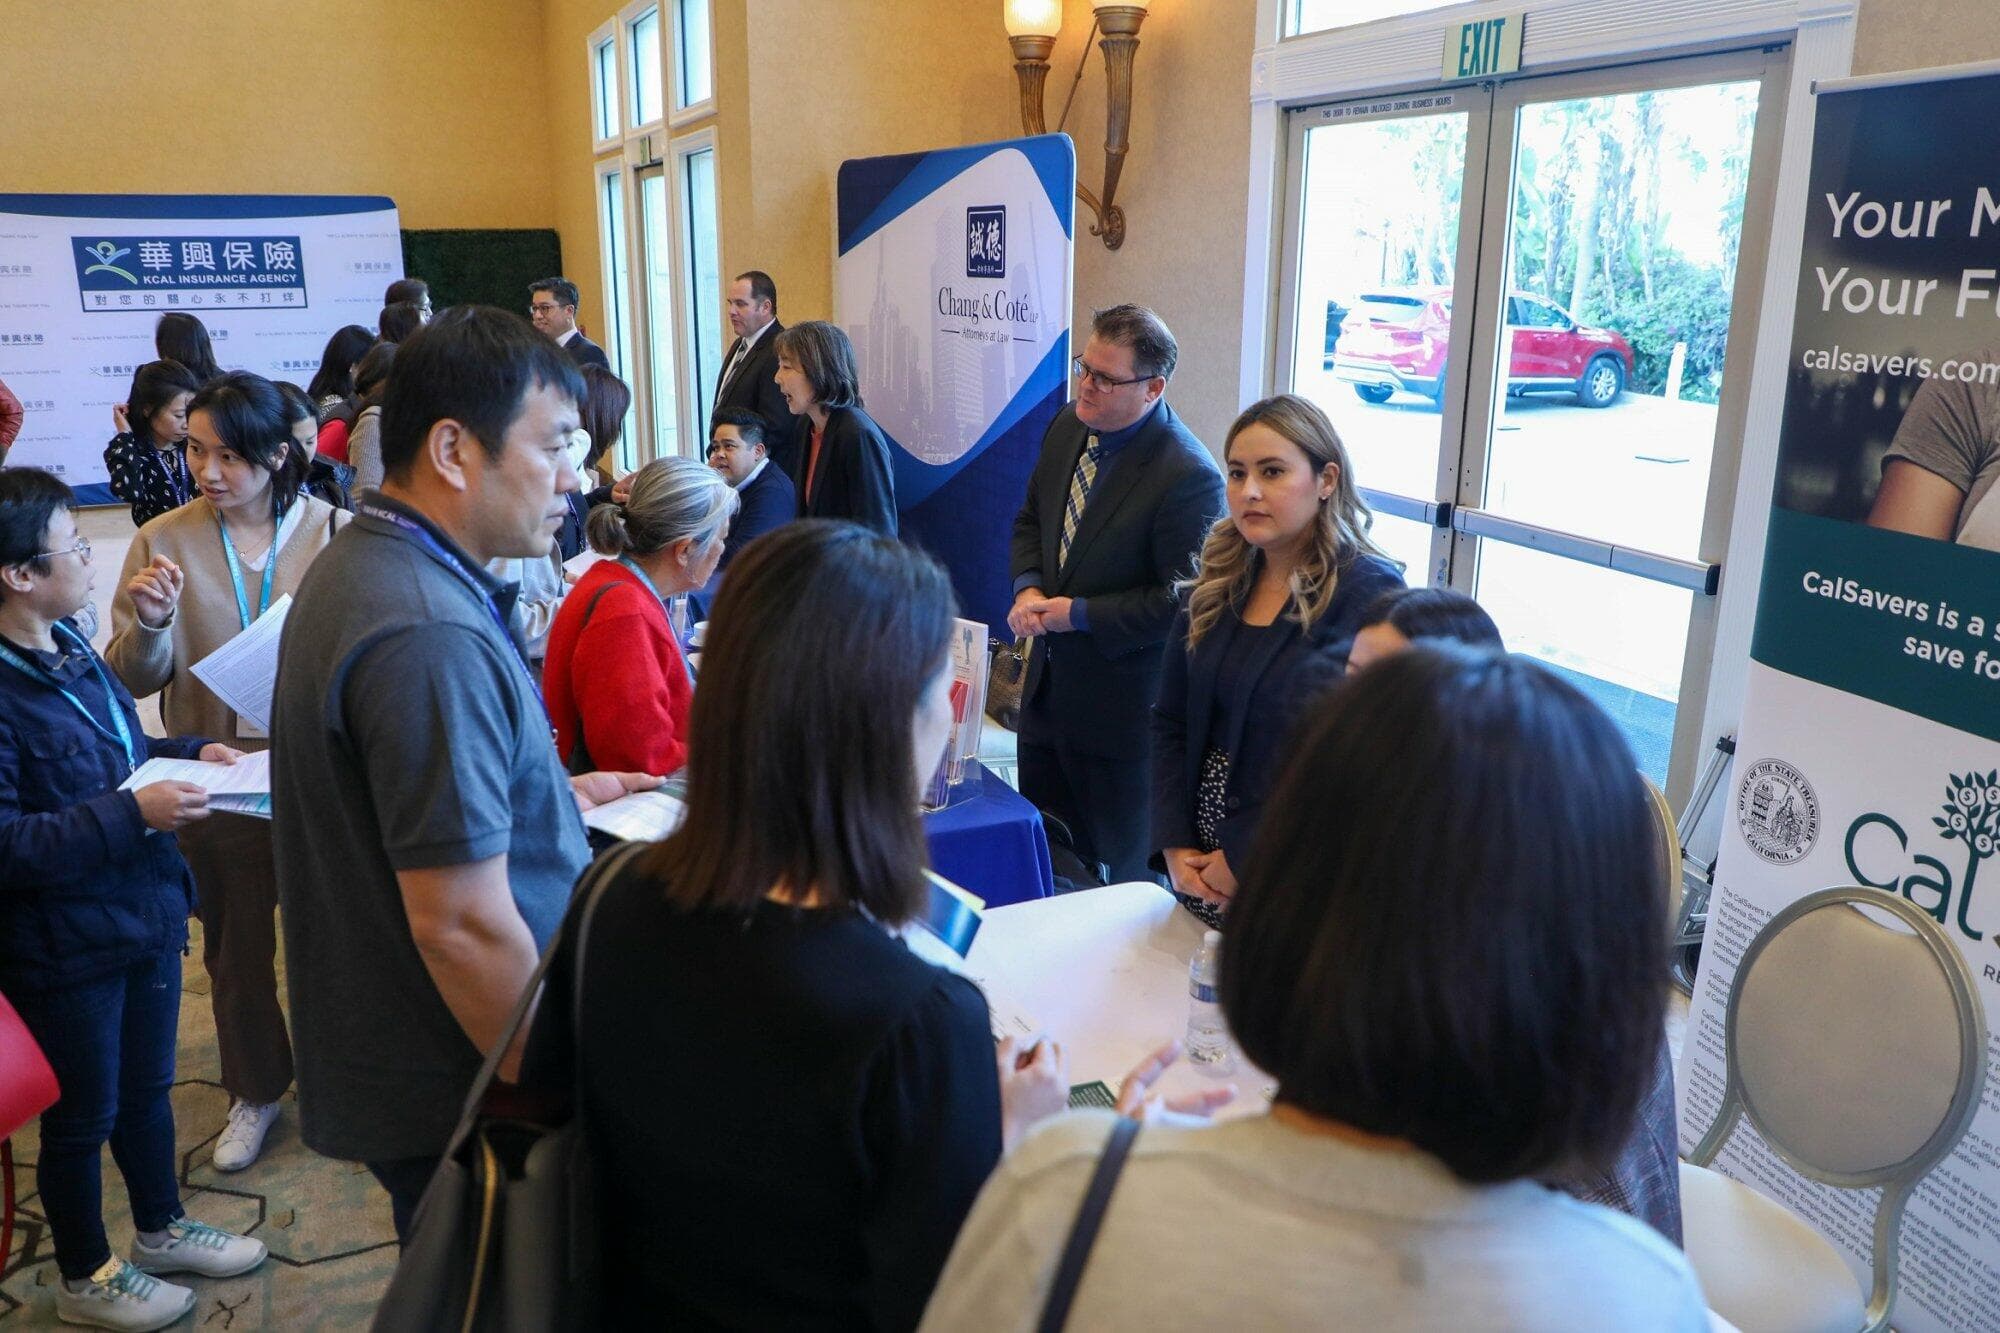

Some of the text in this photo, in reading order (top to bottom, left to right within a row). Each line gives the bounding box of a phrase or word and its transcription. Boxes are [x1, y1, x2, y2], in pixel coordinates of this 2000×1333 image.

[1458, 18, 1506, 77] EXIT
[1352, 107, 1369, 115] REMAIN
[1370, 104, 1392, 113] UNLOCKED
[1393, 101, 1410, 111] DURING
[1411, 99, 1433, 109] BUSINESS
[1435, 96, 1452, 106] HOURS
[1825, 192, 1951, 238] Your
[138, 241, 296, 271] 華興保險
[143, 273, 297, 285] KCAL INSURANCE AGENCY
[1815, 267, 2000, 319] Your F
[938, 286, 979, 325] Chang
[981, 293, 993, 319] &
[995, 290, 1028, 323] Coté
[1803, 345, 2000, 384] calsavers.com
[1803, 571, 1929, 622] CalSavers
[1936, 602, 1959, 630] is
[1967, 615, 1985, 637] a
[1903, 636, 1965, 669] save
[1758, 763, 1773, 773] THE
[1774, 764, 1799, 785] STATE
[1721, 897, 1746, 918] California
[1733, 894, 1764, 915] CalSavers
[1727, 915, 1752, 932] program
[1765, 1157, 1796, 1183] questions
[1794, 1201, 1818, 1224] Section
[1799, 1193, 1835, 1224] Employers
